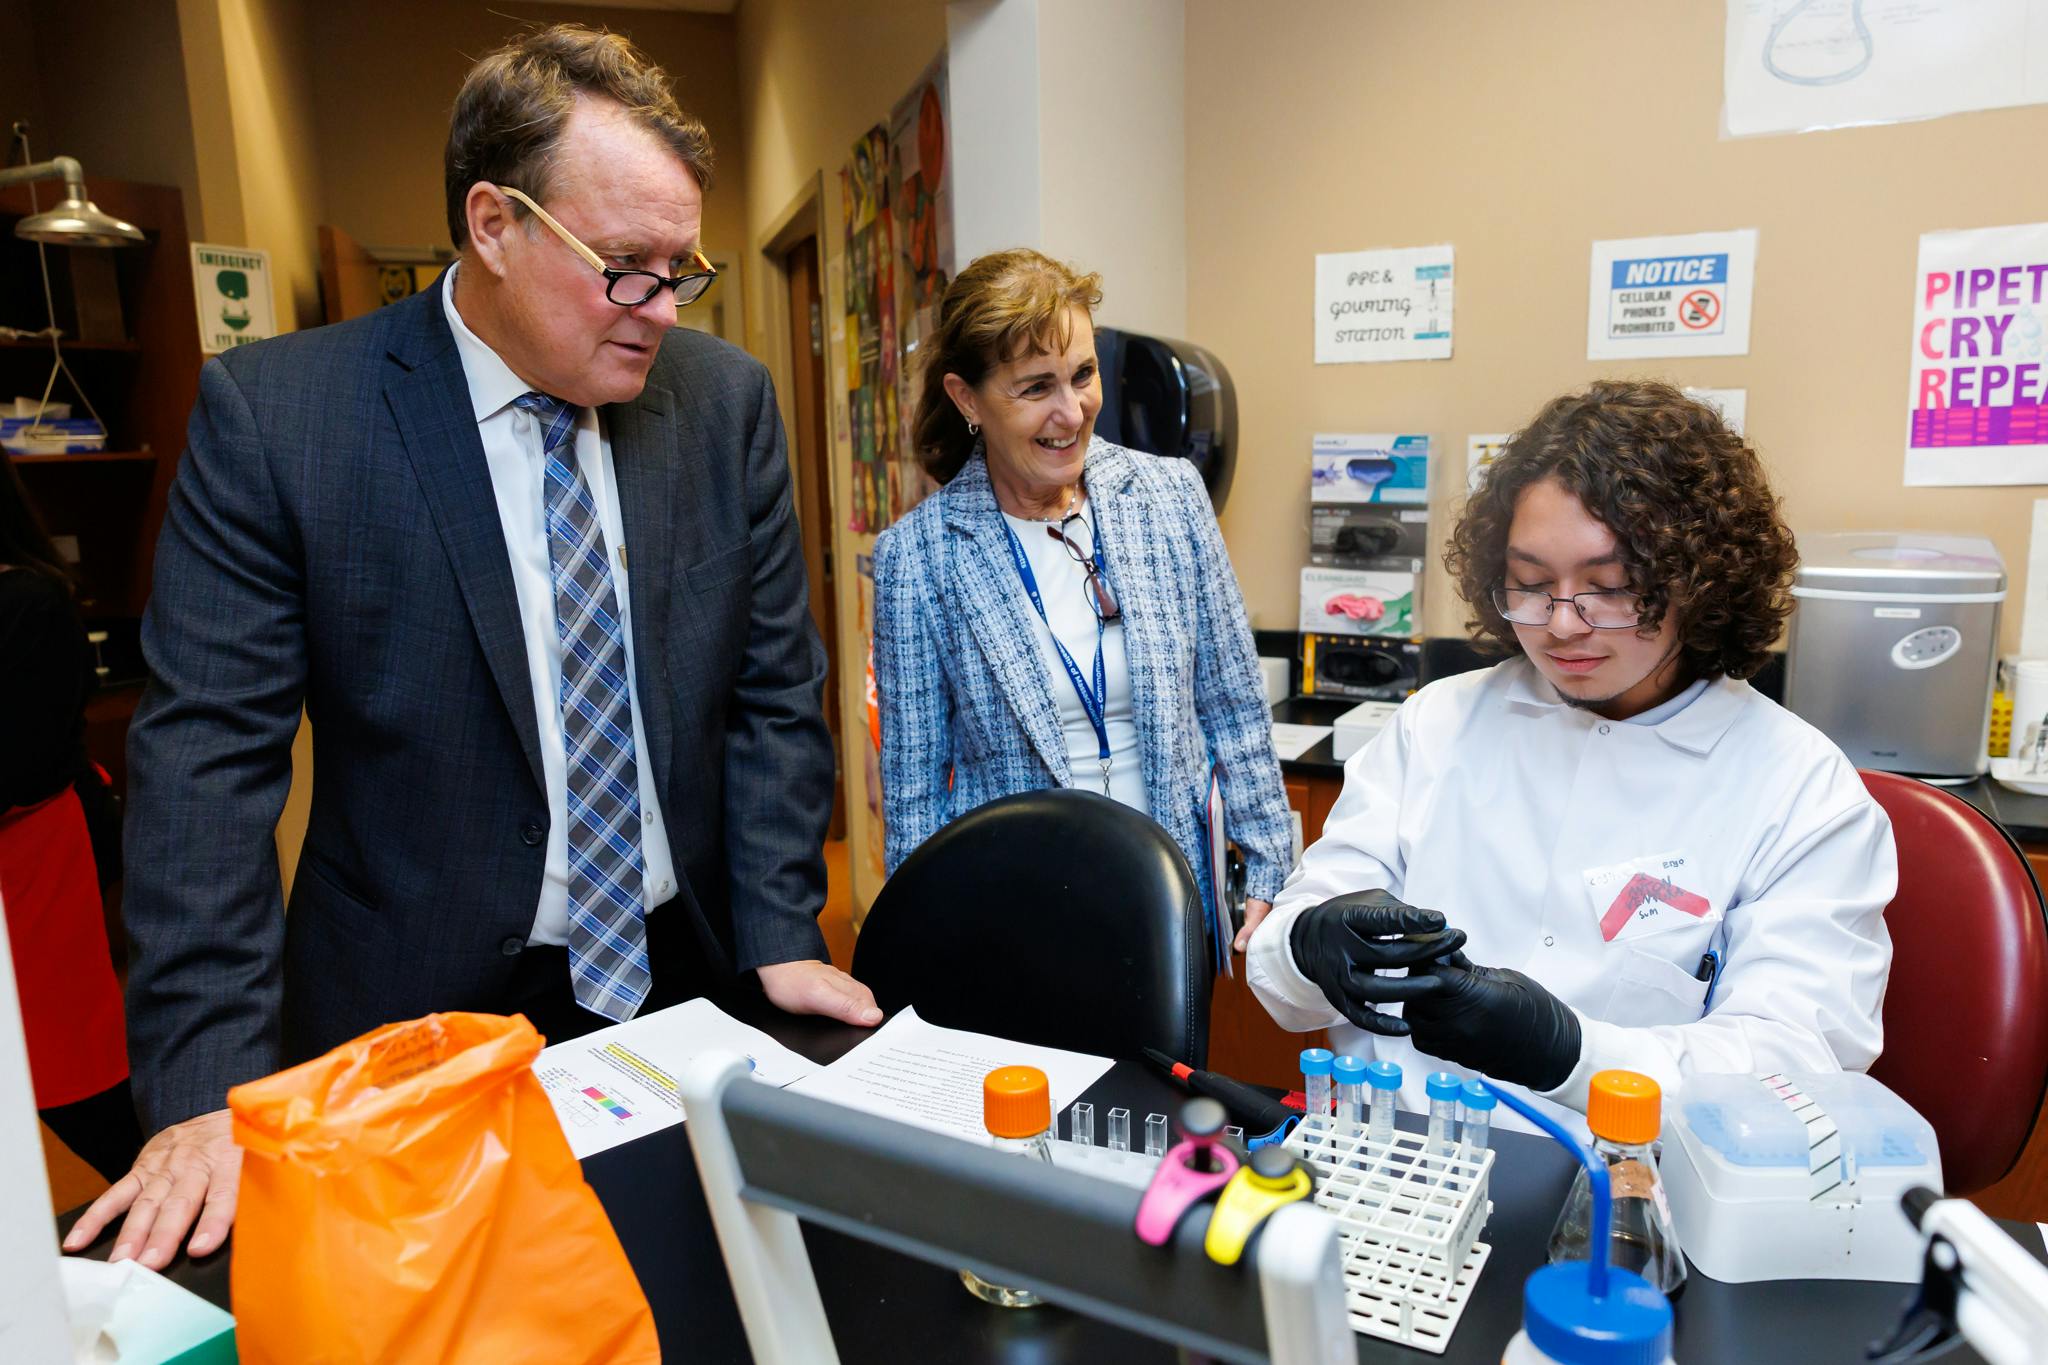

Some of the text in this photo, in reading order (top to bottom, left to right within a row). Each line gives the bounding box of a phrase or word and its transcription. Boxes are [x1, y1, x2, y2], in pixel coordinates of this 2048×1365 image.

[200, 253, 262, 270] EMERGENCY
[1626, 258, 1717, 285] NOTICE
[1619, 291, 1671, 304] CELLULAR
[1623, 306, 1666, 318] PHONES
[1612, 321, 1675, 334] PROHIBITED
[1920, 314, 2016, 360] CRY
